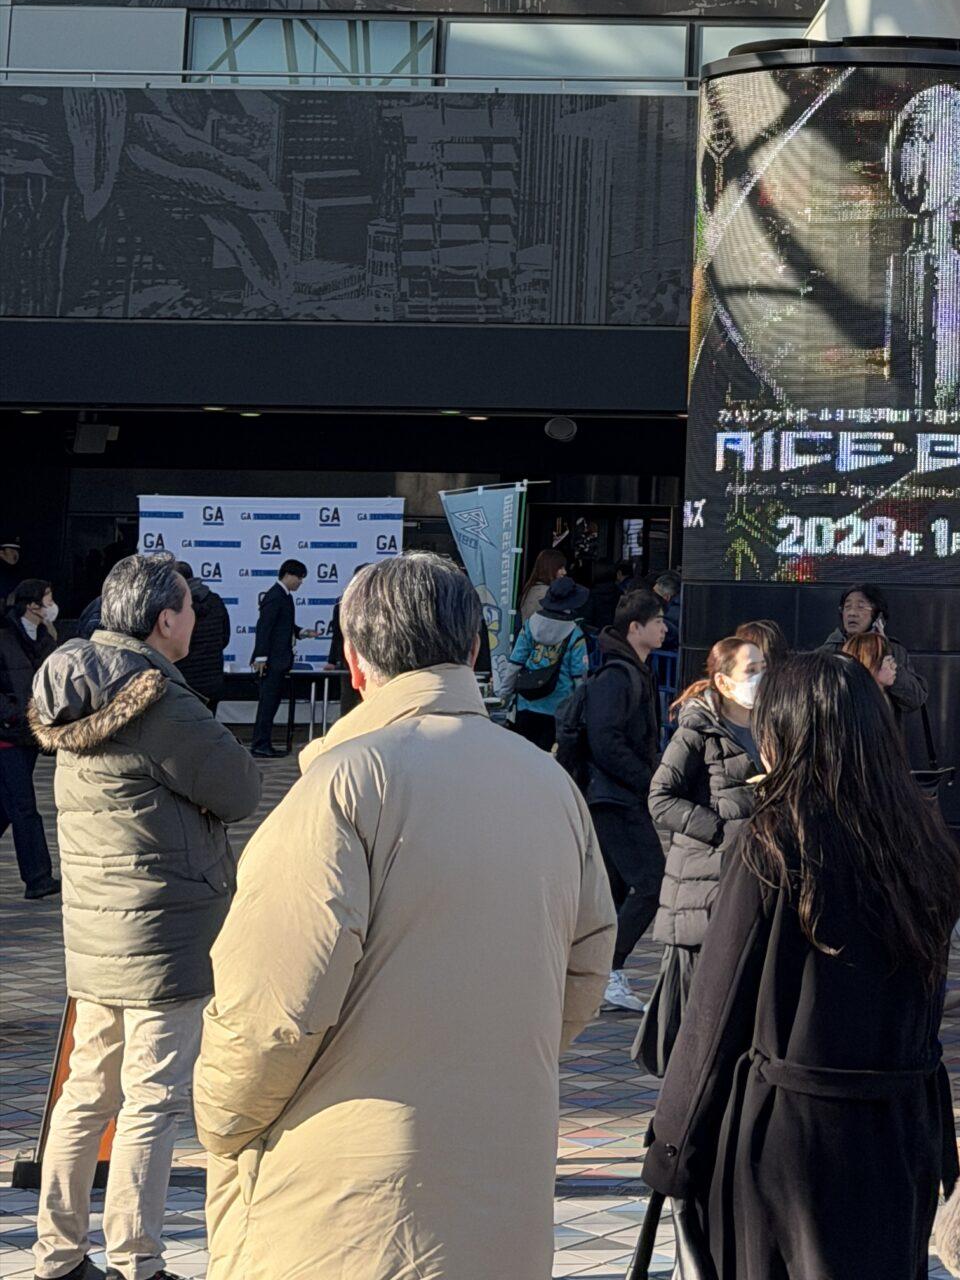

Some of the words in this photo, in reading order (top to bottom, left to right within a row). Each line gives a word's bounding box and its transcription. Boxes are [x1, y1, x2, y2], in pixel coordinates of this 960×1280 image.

[203, 505, 224, 522] GA
[319, 507, 340, 523] GA
[143, 533, 165, 549] GA
[260, 535, 281, 551] GA
[376, 535, 397, 551] GA
[201, 562, 222, 578] GA
[317, 564, 338, 579] GA
